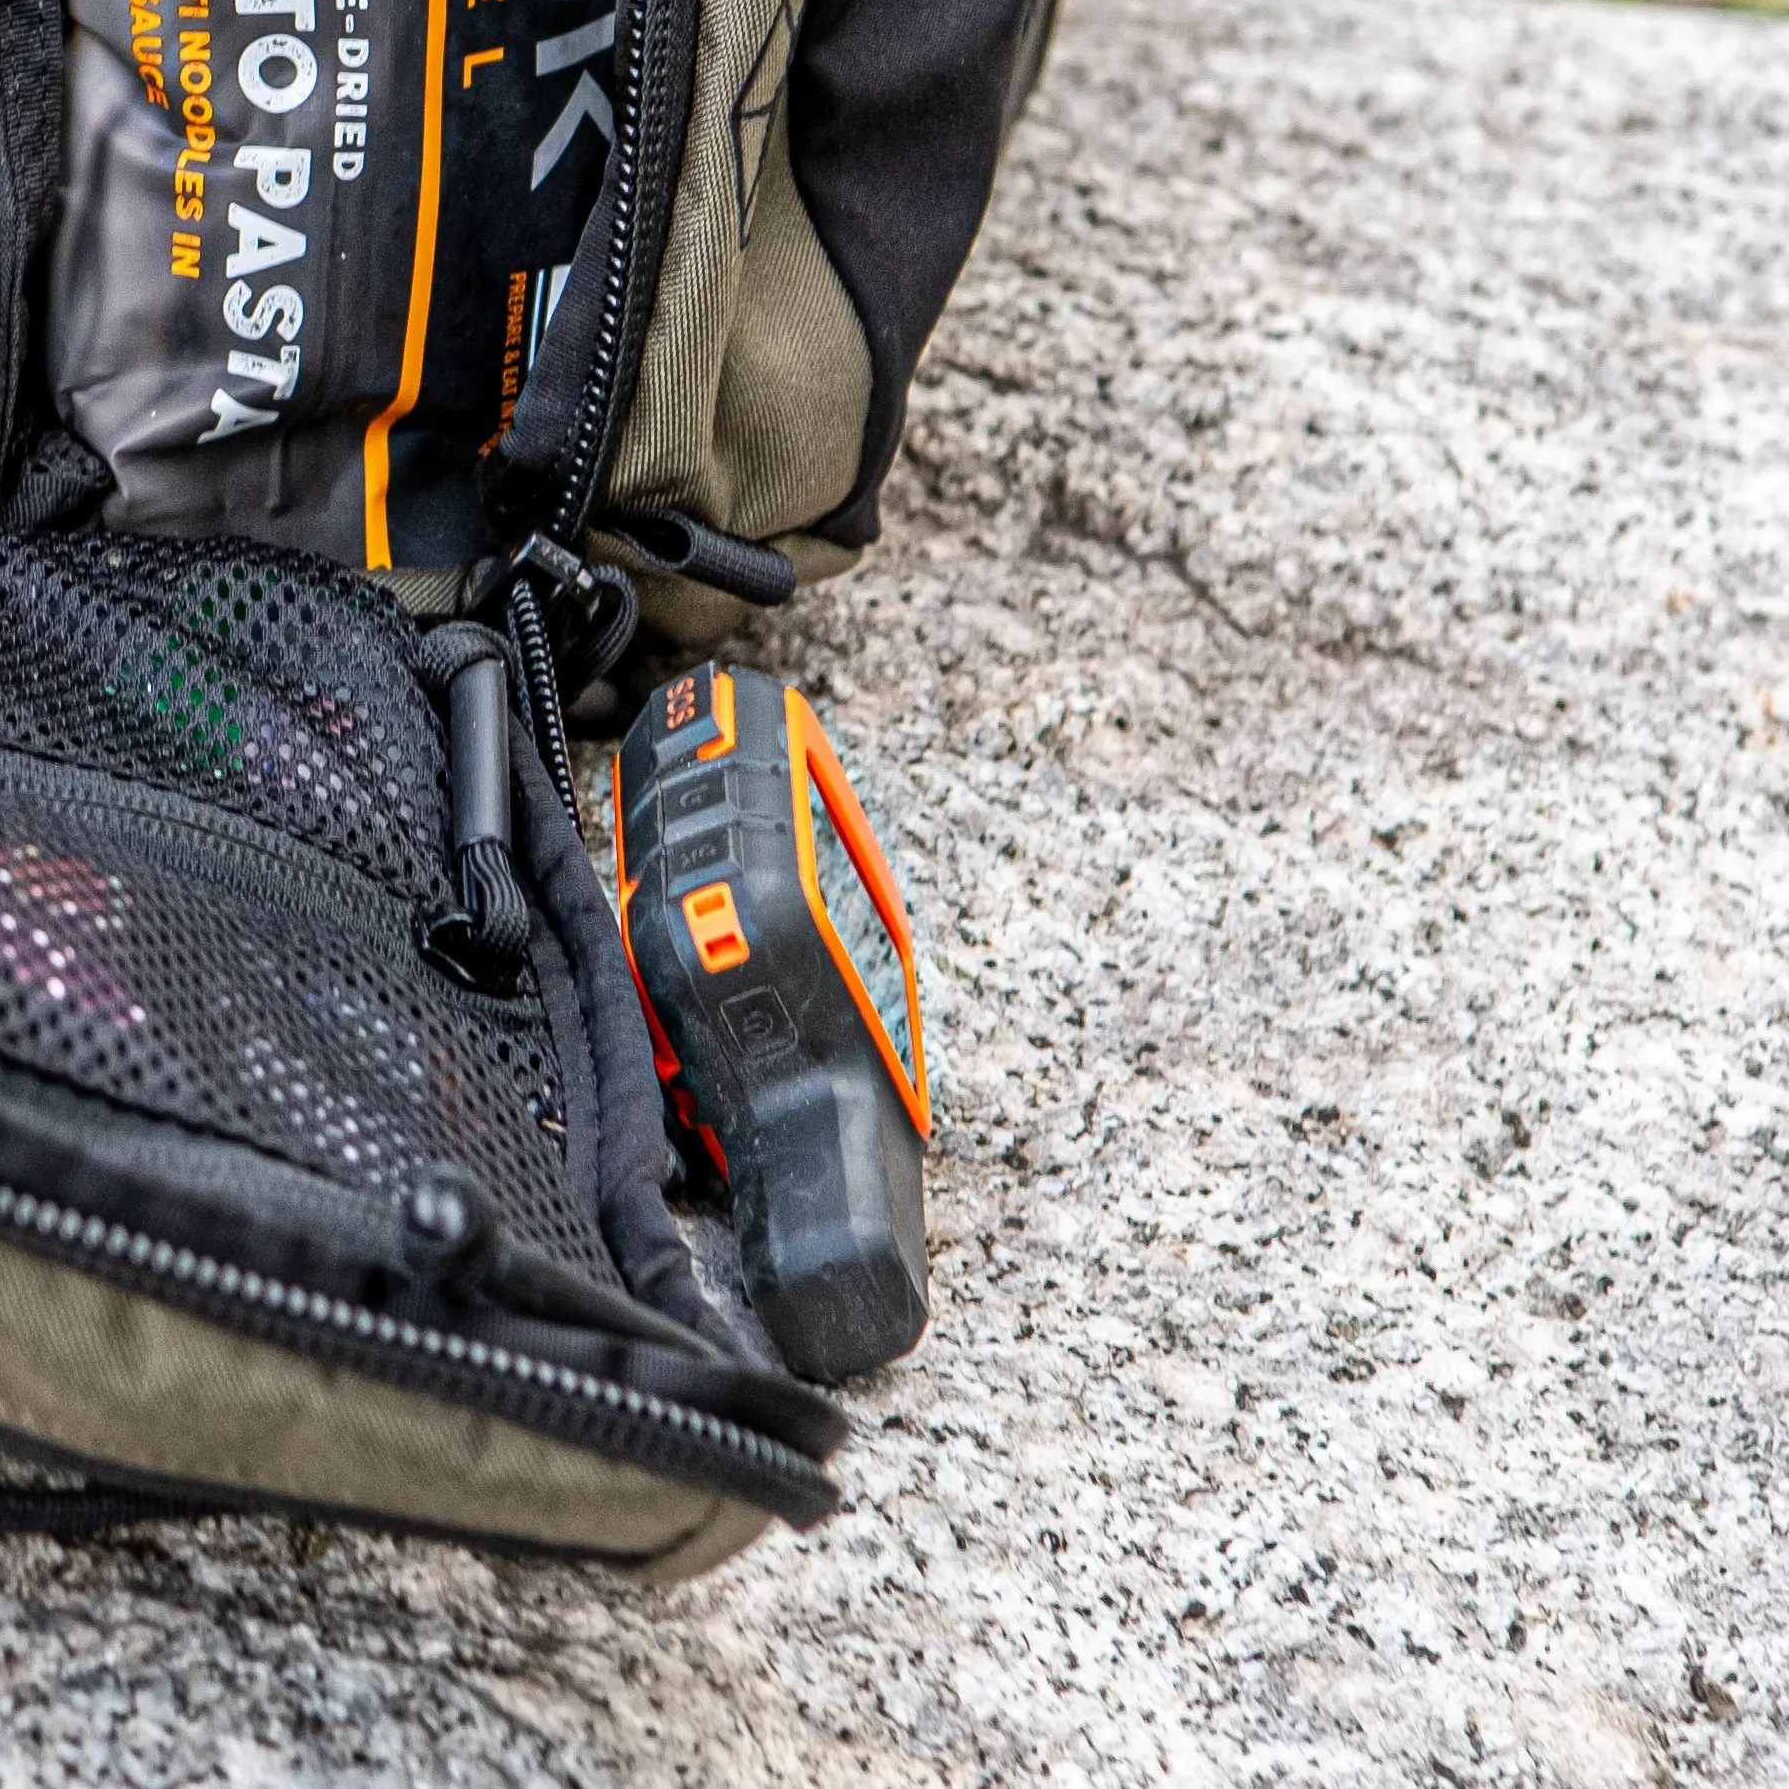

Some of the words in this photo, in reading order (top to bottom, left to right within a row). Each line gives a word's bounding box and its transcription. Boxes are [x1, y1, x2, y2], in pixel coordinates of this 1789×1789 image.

[174, 31, 217, 223] NOODLES
[171, 231, 202, 279] IN
[197, 145, 312, 445] PASTA
[667, 677, 696, 730] SOS
